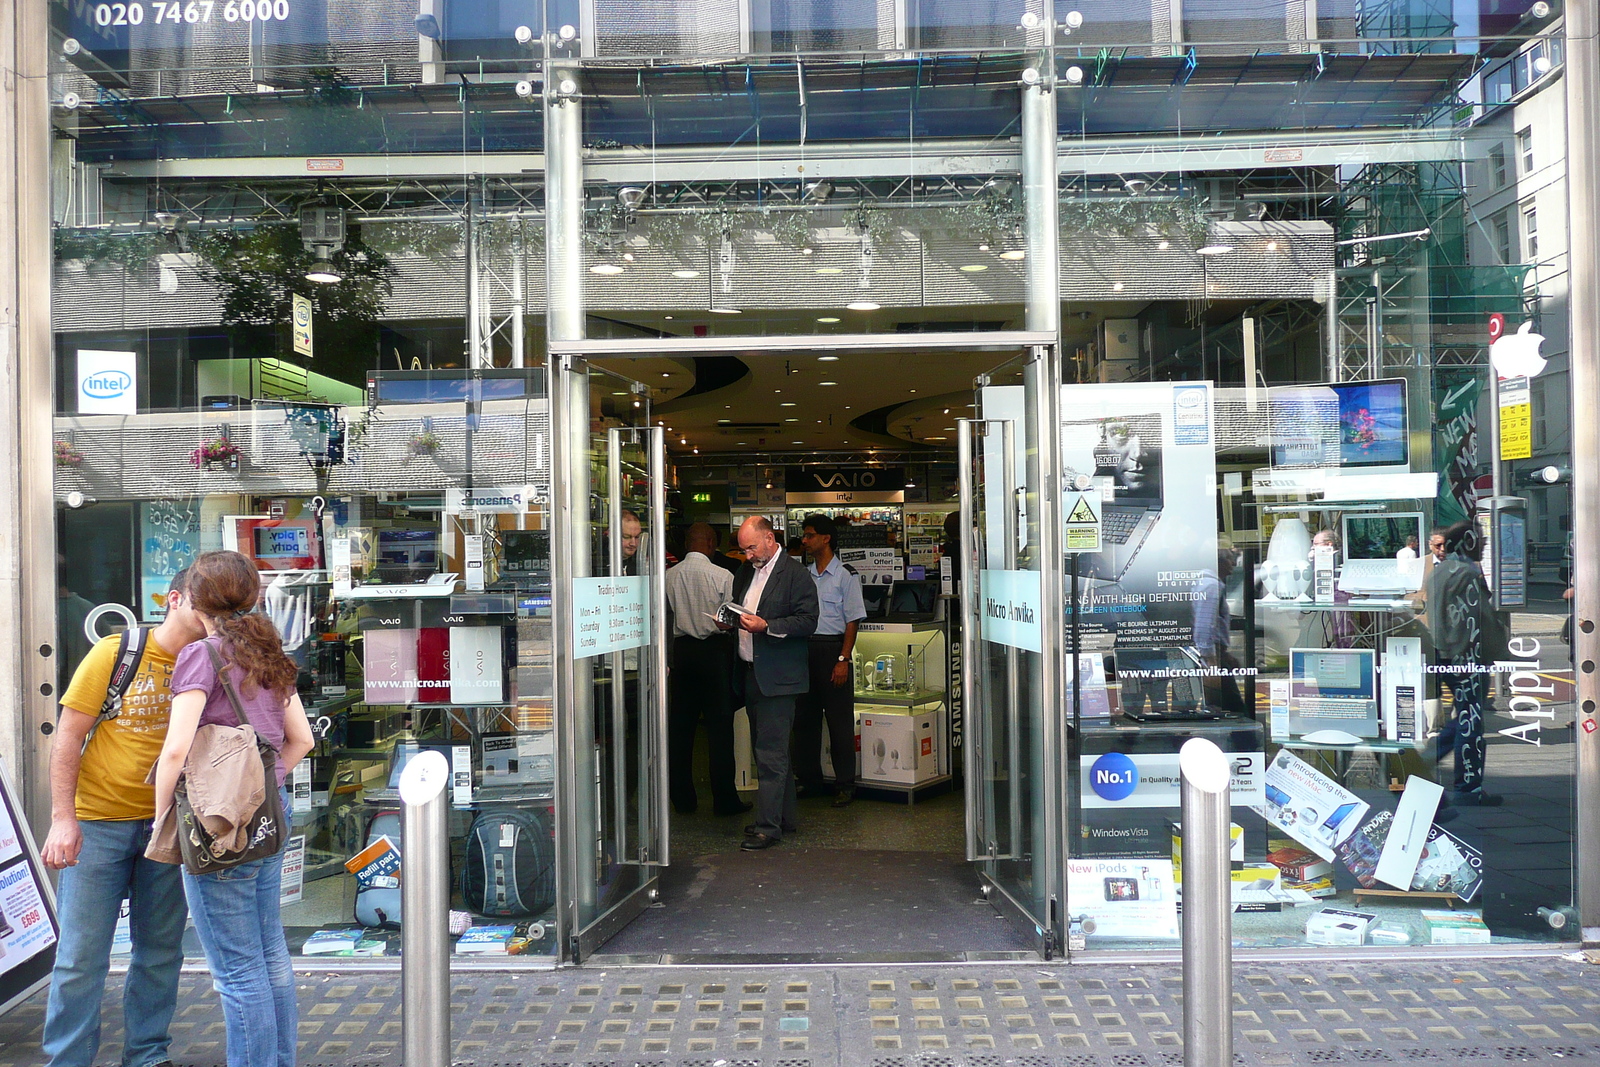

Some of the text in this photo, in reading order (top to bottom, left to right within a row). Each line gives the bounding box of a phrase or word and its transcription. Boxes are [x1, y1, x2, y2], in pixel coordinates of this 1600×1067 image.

[95, 2, 144, 26] 020
[152, 1, 214, 24] 7467
[223, 0, 290, 22] 6000
[88, 376, 124, 390] intel
[1442, 400, 1476, 448] NEW
[813, 472, 876, 488] VAIO
[836, 493, 853, 502] intel
[598, 584, 628, 596] Trading Hours
[1092, 594, 1118, 604] WITH
[1121, 594, 1146, 603] HIGH
[1150, 592, 1206, 602] DEFINITION
[580, 608, 590, 617] Mon
[986, 598, 1034, 624] Micro Anvika
[1110, 605, 1146, 613] NOTEBOOK
[580, 621, 600, 632] Saturday
[1466, 616, 1480, 642] 2
[580, 637, 596, 647] Sunday
[1118, 666, 1258, 678] www.microanvika.com
[1376, 663, 1516, 674] www.microanvika.com
[366, 678, 500, 688] www.microanvika.com
[952, 642, 962, 747] SAMSUNG
[1494, 637, 1554, 747] Apple
[1097, 770, 1132, 784] No.1
[1148, 776, 1173, 785] Quality
[1287, 769, 1322, 794] new iMac
[1292, 760, 1334, 792] Introducing
[1334, 788, 1347, 800] the
[1092, 828, 1148, 837] Windows Vista
[358, 852, 395, 880] Refill pad
[1095, 863, 1127, 873] iPods
[21, 910, 41, 928] £699
